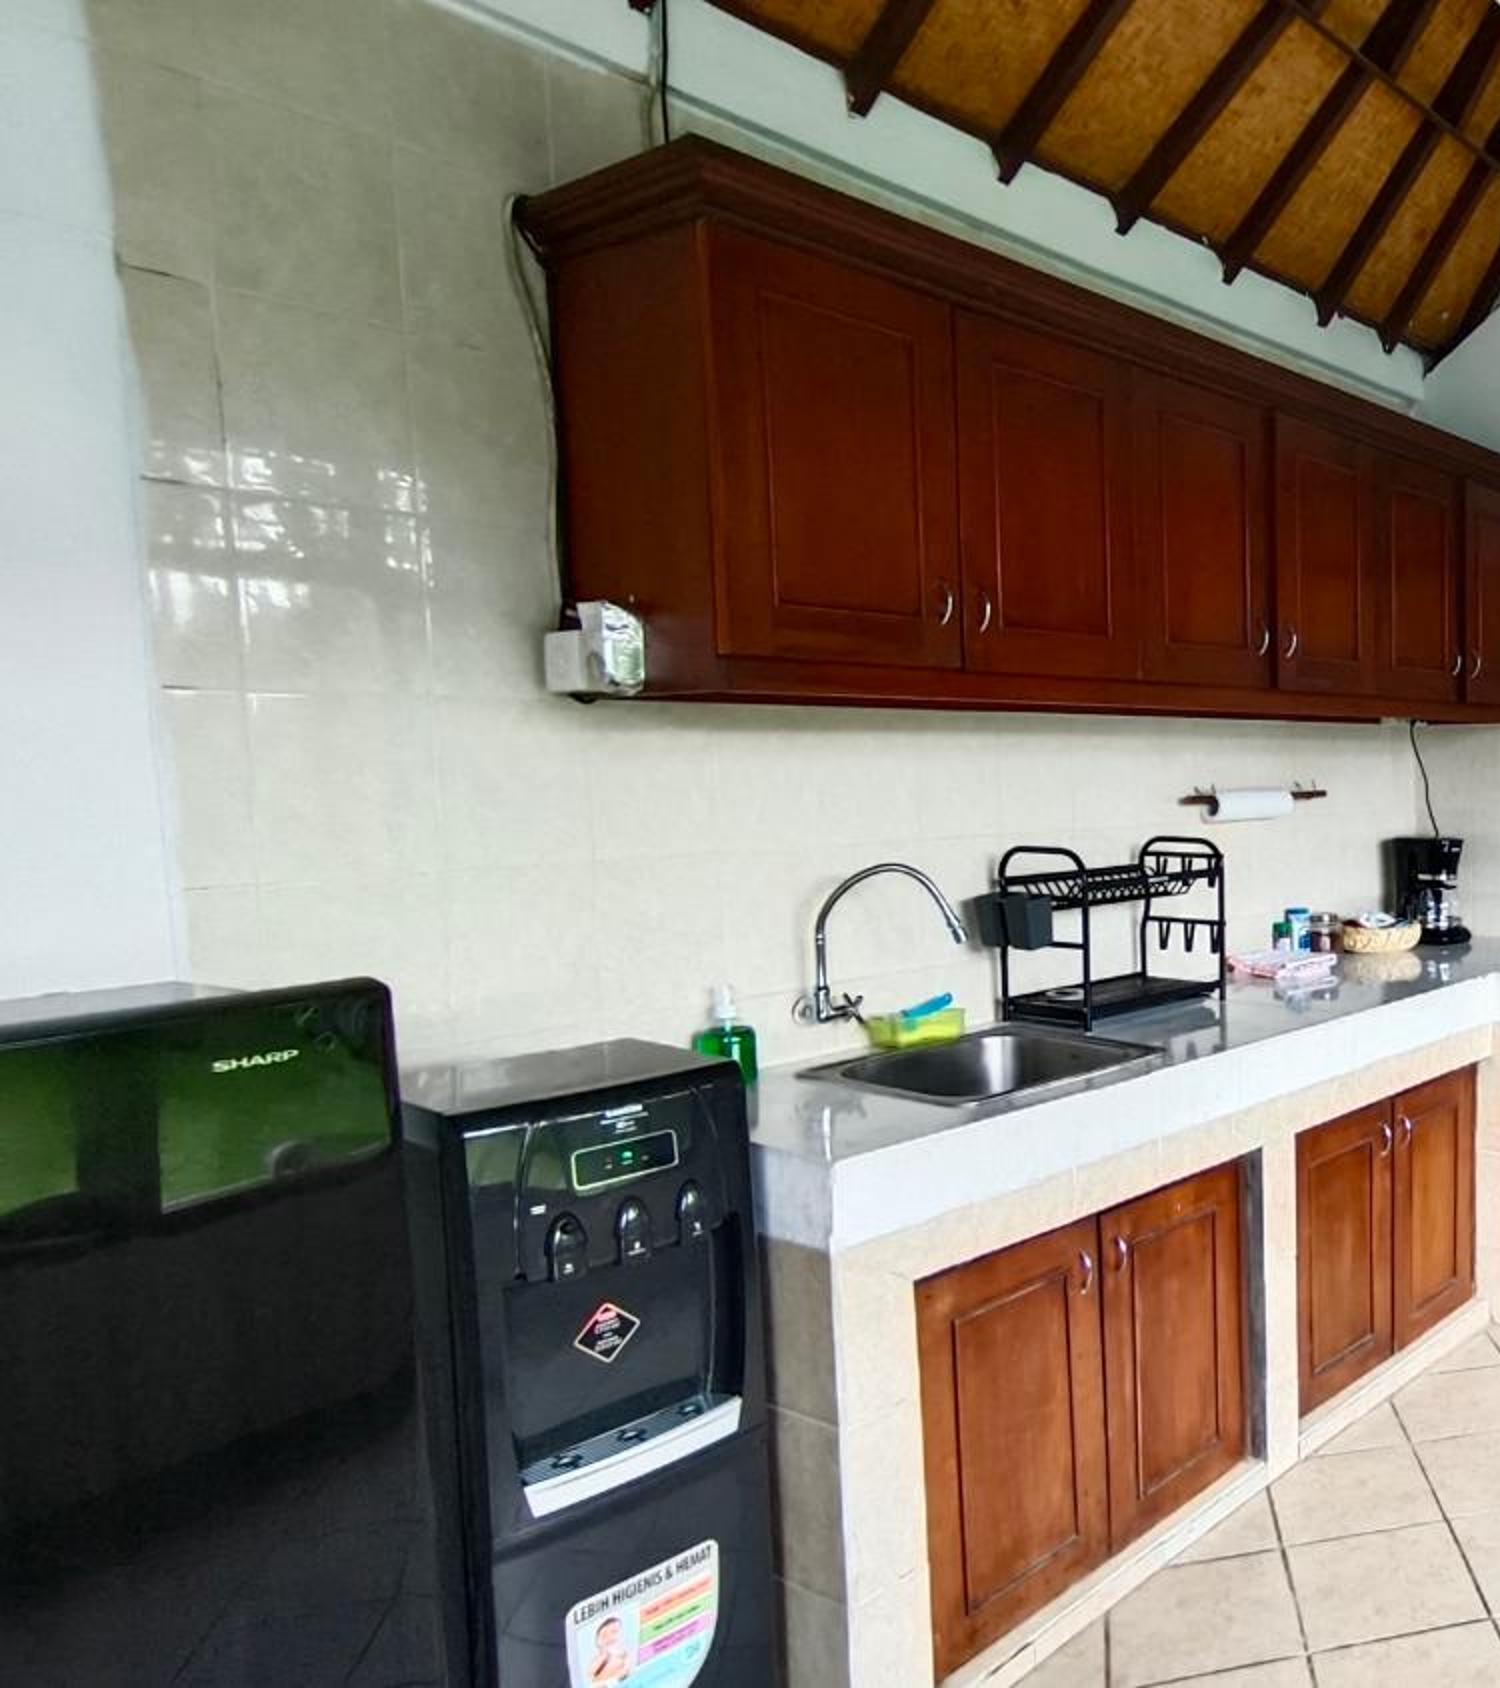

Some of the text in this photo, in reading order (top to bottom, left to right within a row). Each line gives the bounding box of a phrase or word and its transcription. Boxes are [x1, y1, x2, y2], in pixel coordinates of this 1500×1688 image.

[211, 1049, 300, 1073] SHARP
[573, 1597, 609, 1625] LEBIH
[612, 1571, 663, 1605] HIGIENIS
[665, 1566, 674, 1580] &
[676, 1546, 712, 1573] HEMAT
